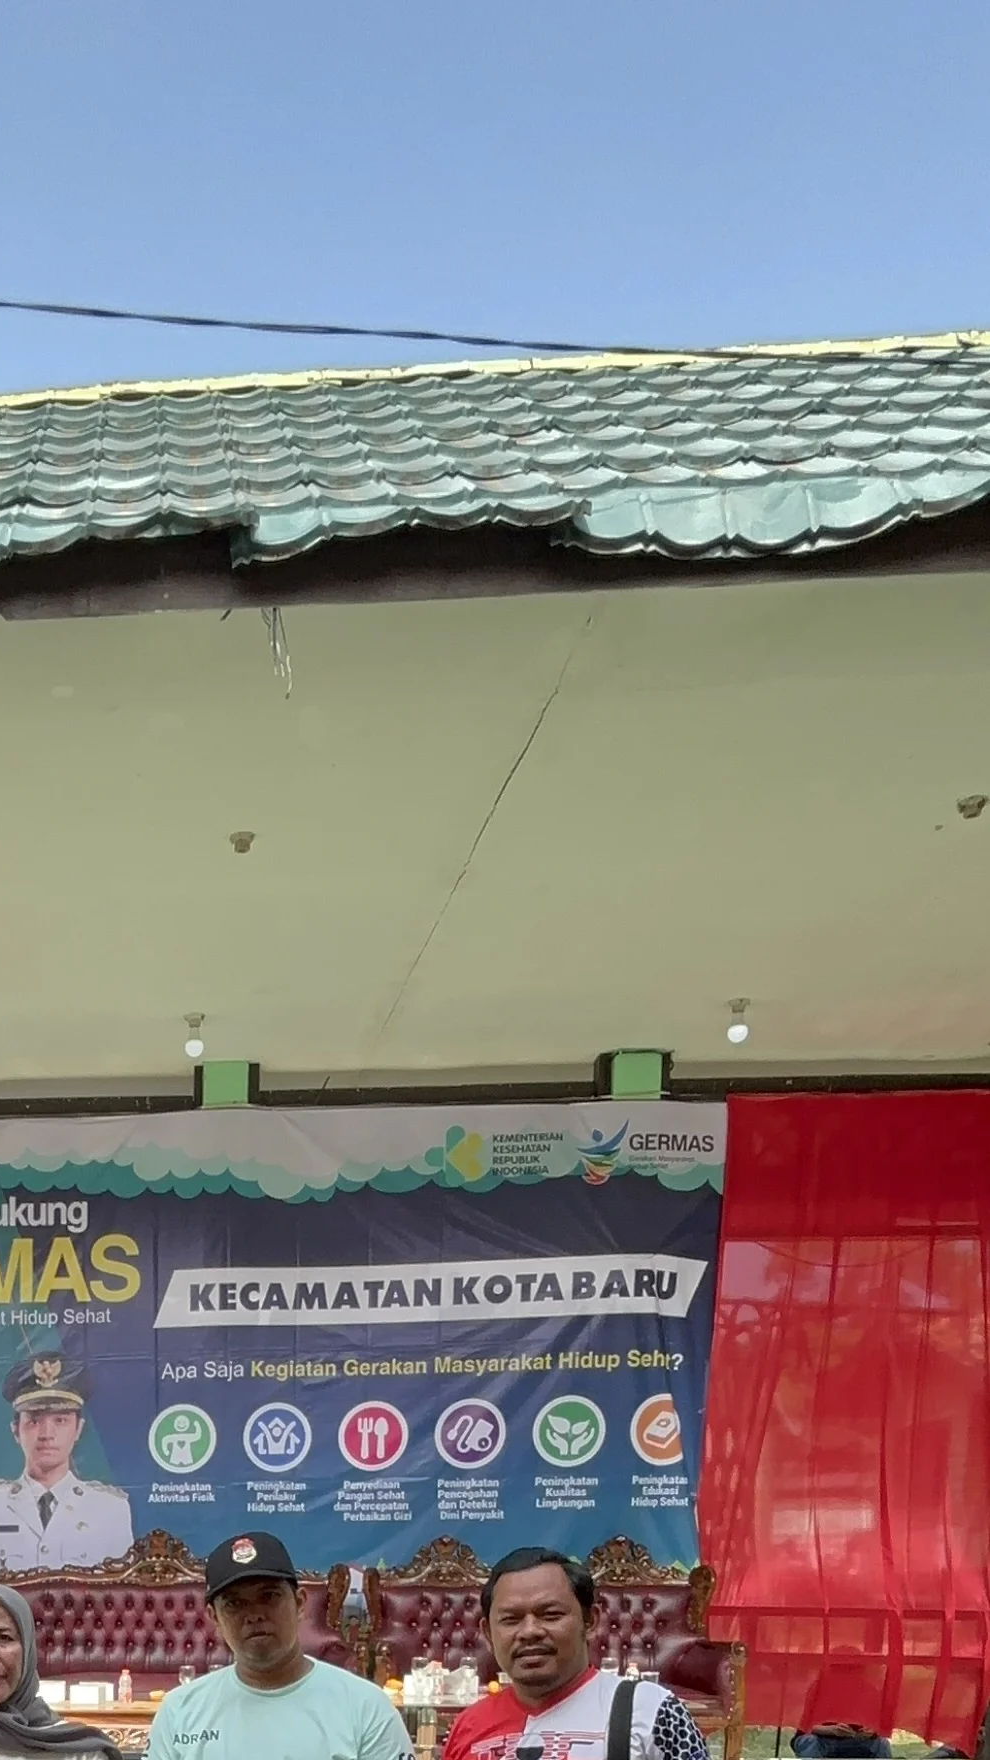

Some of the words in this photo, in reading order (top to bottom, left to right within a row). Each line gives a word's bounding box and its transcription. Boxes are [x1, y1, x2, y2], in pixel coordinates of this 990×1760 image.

[492, 1132, 563, 1142] KEMENTERIAN
[629, 1133, 714, 1152] GERMAS
[492, 1144, 551, 1153] KESEHATAN
[492, 1155, 540, 1164] REPUBLIK
[492, 1165, 549, 1176] INDONESIA
[188, 1278, 441, 1312] KECAMATAN
[452, 1271, 564, 1306] KOTA
[571, 1267, 678, 1301] BARU
[11, 1310, 58, 1327] Hidup
[63, 1309, 111, 1324] Sehat
[161, 1362, 198, 1382] Apa
[203, 1360, 244, 1381] Saja
[251, 1358, 337, 1380] Kegiatan
[343, 1356, 428, 1376] Gerakan
[434, 1352, 552, 1374] Masyarakat
[559, 1350, 620, 1372] Hidup
[627, 1349, 683, 1370] Seht?
[152, 1482, 212, 1494] Peningkatan
[246, 1480, 306, 1492] Peningkatan
[343, 1480, 400, 1492] Penyediaan
[437, 1478, 499, 1490] Peningkatan
[534, 1476, 598, 1488] Peningkatan
[338, 1491, 375, 1502] Pangan
[377, 1490, 405, 1500] Sehat
[437, 1489, 498, 1501] Pencegahan
[545, 1487, 587, 1497] Kualitas
[642, 1486, 679, 1495] Edukasi
[148, 1492, 190, 1503] Aktivitas
[192, 1492, 215, 1503] Fisik
[535, 1498, 595, 1509] Lingkungan
[631, 1497, 658, 1508] Hidup
[660, 1496, 689, 1507] Sehat
[246, 1502, 275, 1513] Hidup
[277, 1502, 305, 1512] Sehat
[333, 1501, 351, 1511] dan
[354, 1501, 409, 1513] Percepatan
[438, 1500, 457, 1510] dan
[460, 1499, 497, 1509] Deteksi
[343, 1511, 391, 1522] Perbaikan
[393, 1511, 412, 1521] Gizi
[440, 1510, 460, 1520] Dini
[461, 1510, 504, 1522] Penyakit
